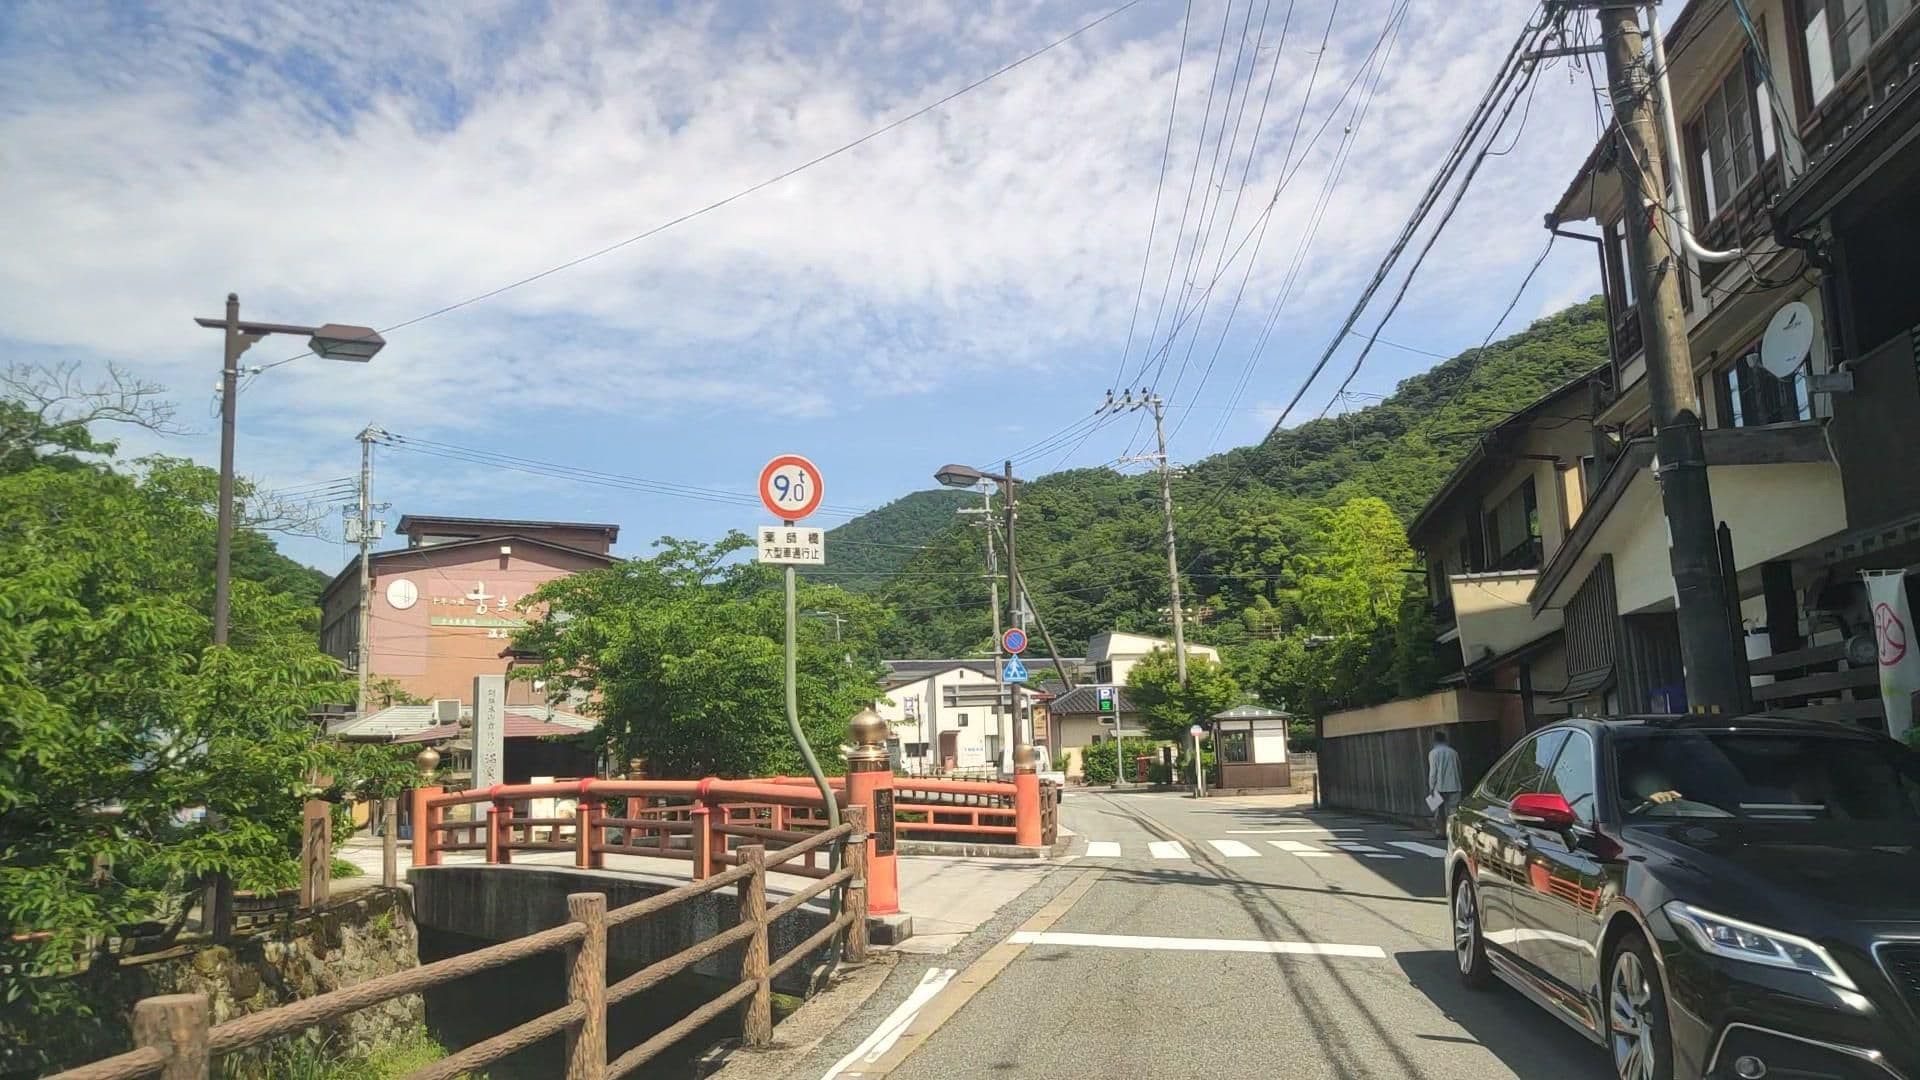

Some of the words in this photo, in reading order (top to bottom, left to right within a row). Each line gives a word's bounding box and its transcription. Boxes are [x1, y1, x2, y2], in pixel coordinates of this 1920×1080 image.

[774, 475, 804, 502] 9.0
[764, 547, 819, 560] 大型車通行止
